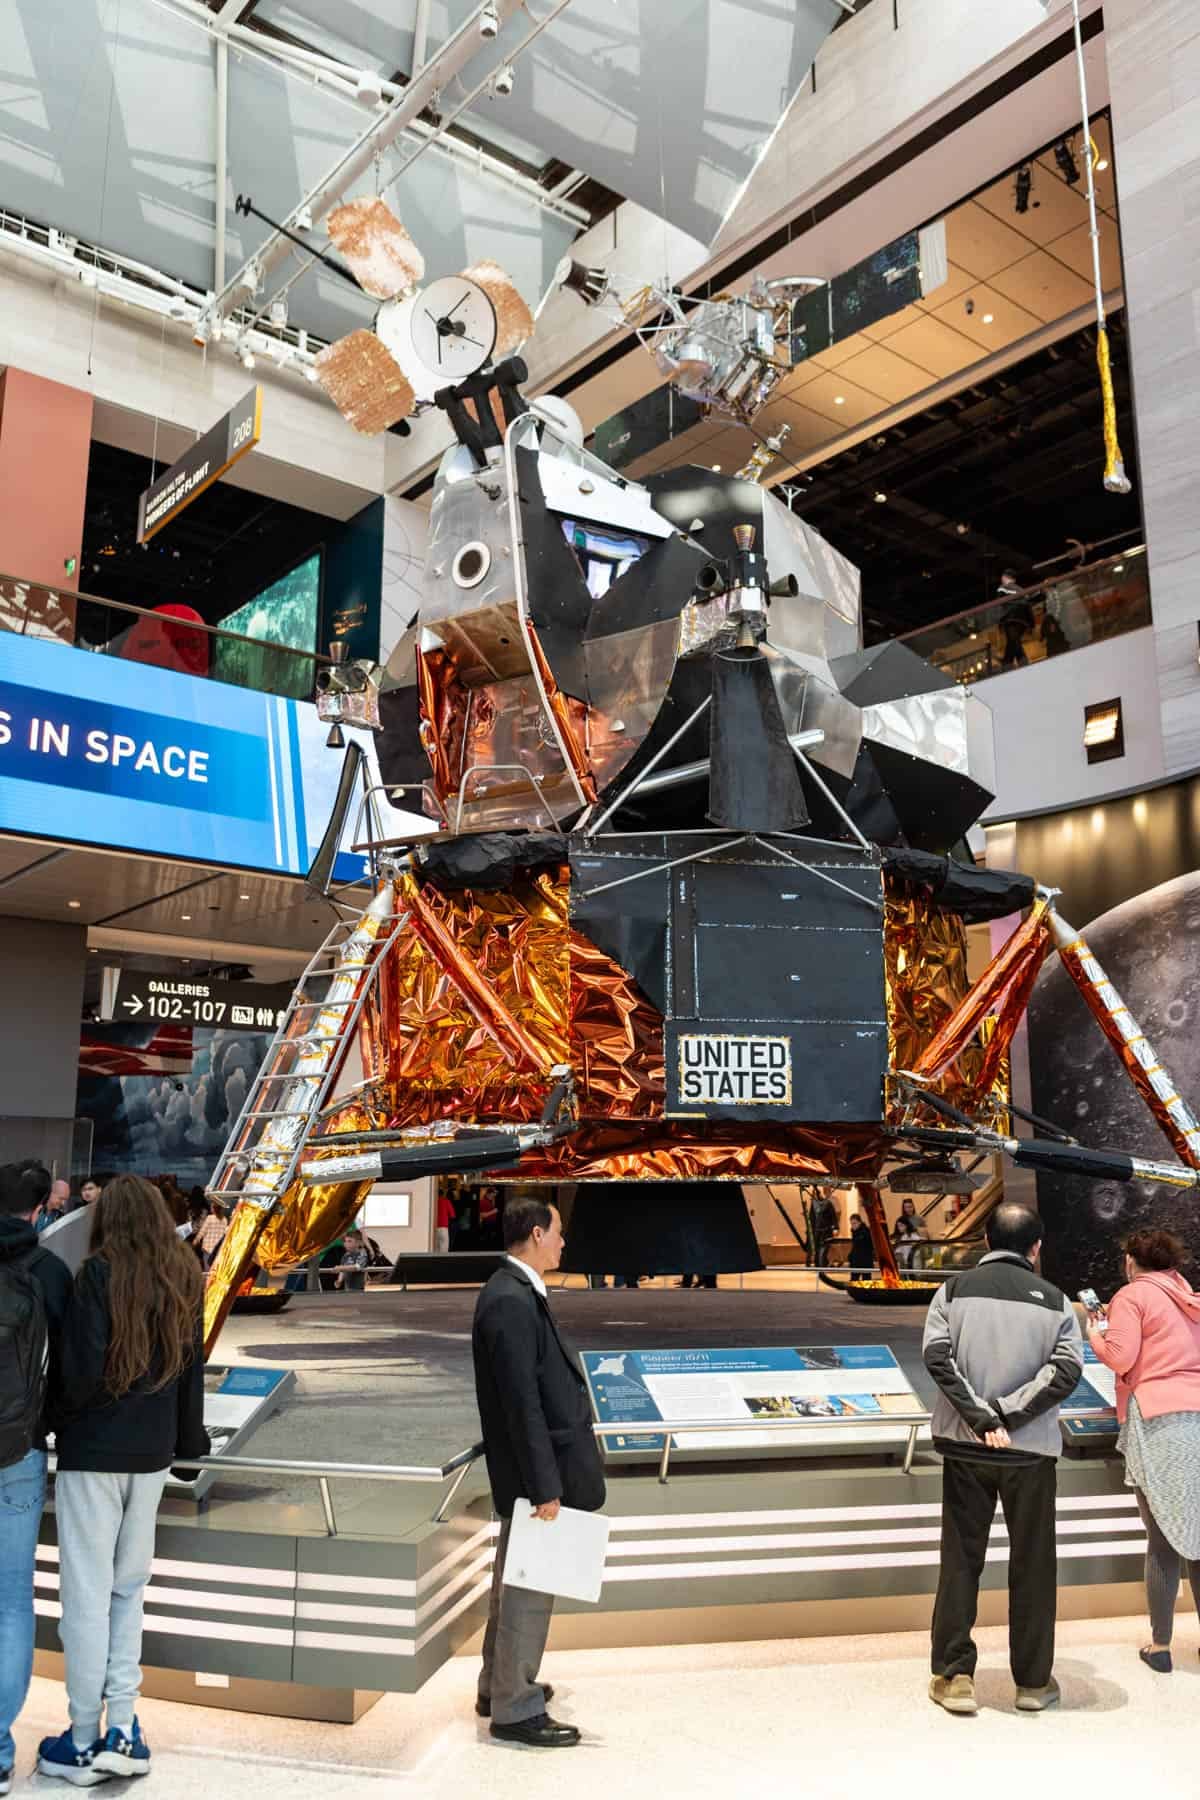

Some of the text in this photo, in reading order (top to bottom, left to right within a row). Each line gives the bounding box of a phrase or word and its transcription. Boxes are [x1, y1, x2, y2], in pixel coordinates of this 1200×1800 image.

[232, 416, 253, 449] 208
[175, 484, 185, 501] OF
[184, 460, 210, 494] FLIGHT
[29, 717, 70, 757] IN
[85, 730, 209, 783] SPACE
[148, 981, 210, 997] GALLERIES
[148, 997, 226, 1022] 102-107
[684, 1040, 786, 1068] UNITED
[684, 1070, 786, 1099] STATES
